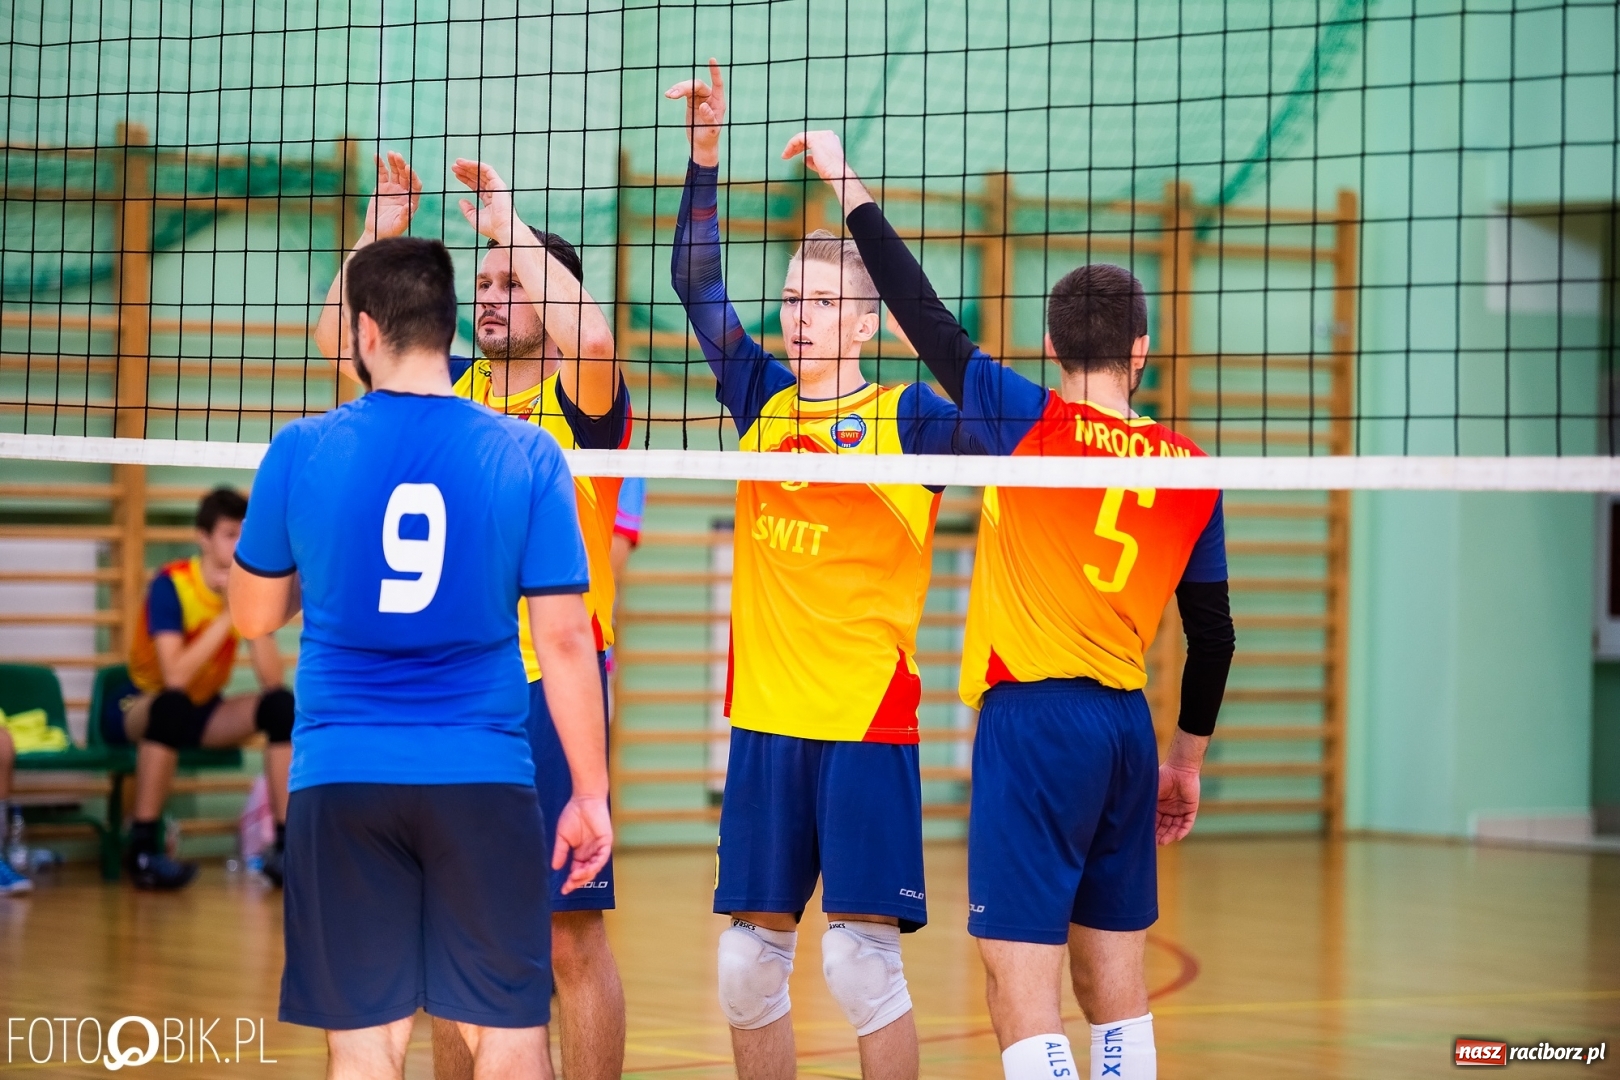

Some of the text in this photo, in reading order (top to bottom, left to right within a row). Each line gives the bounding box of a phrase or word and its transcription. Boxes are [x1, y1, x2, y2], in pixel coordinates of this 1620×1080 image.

[840, 430, 859, 439] ŚWIT
[378, 482, 447, 614] 9
[751, 503, 829, 556] ŚWIT
[1083, 486, 1157, 592] 5
[576, 881, 608, 889] OLO
[899, 888, 925, 900] COLO
[1045, 1041, 1071, 1078] ALLS
